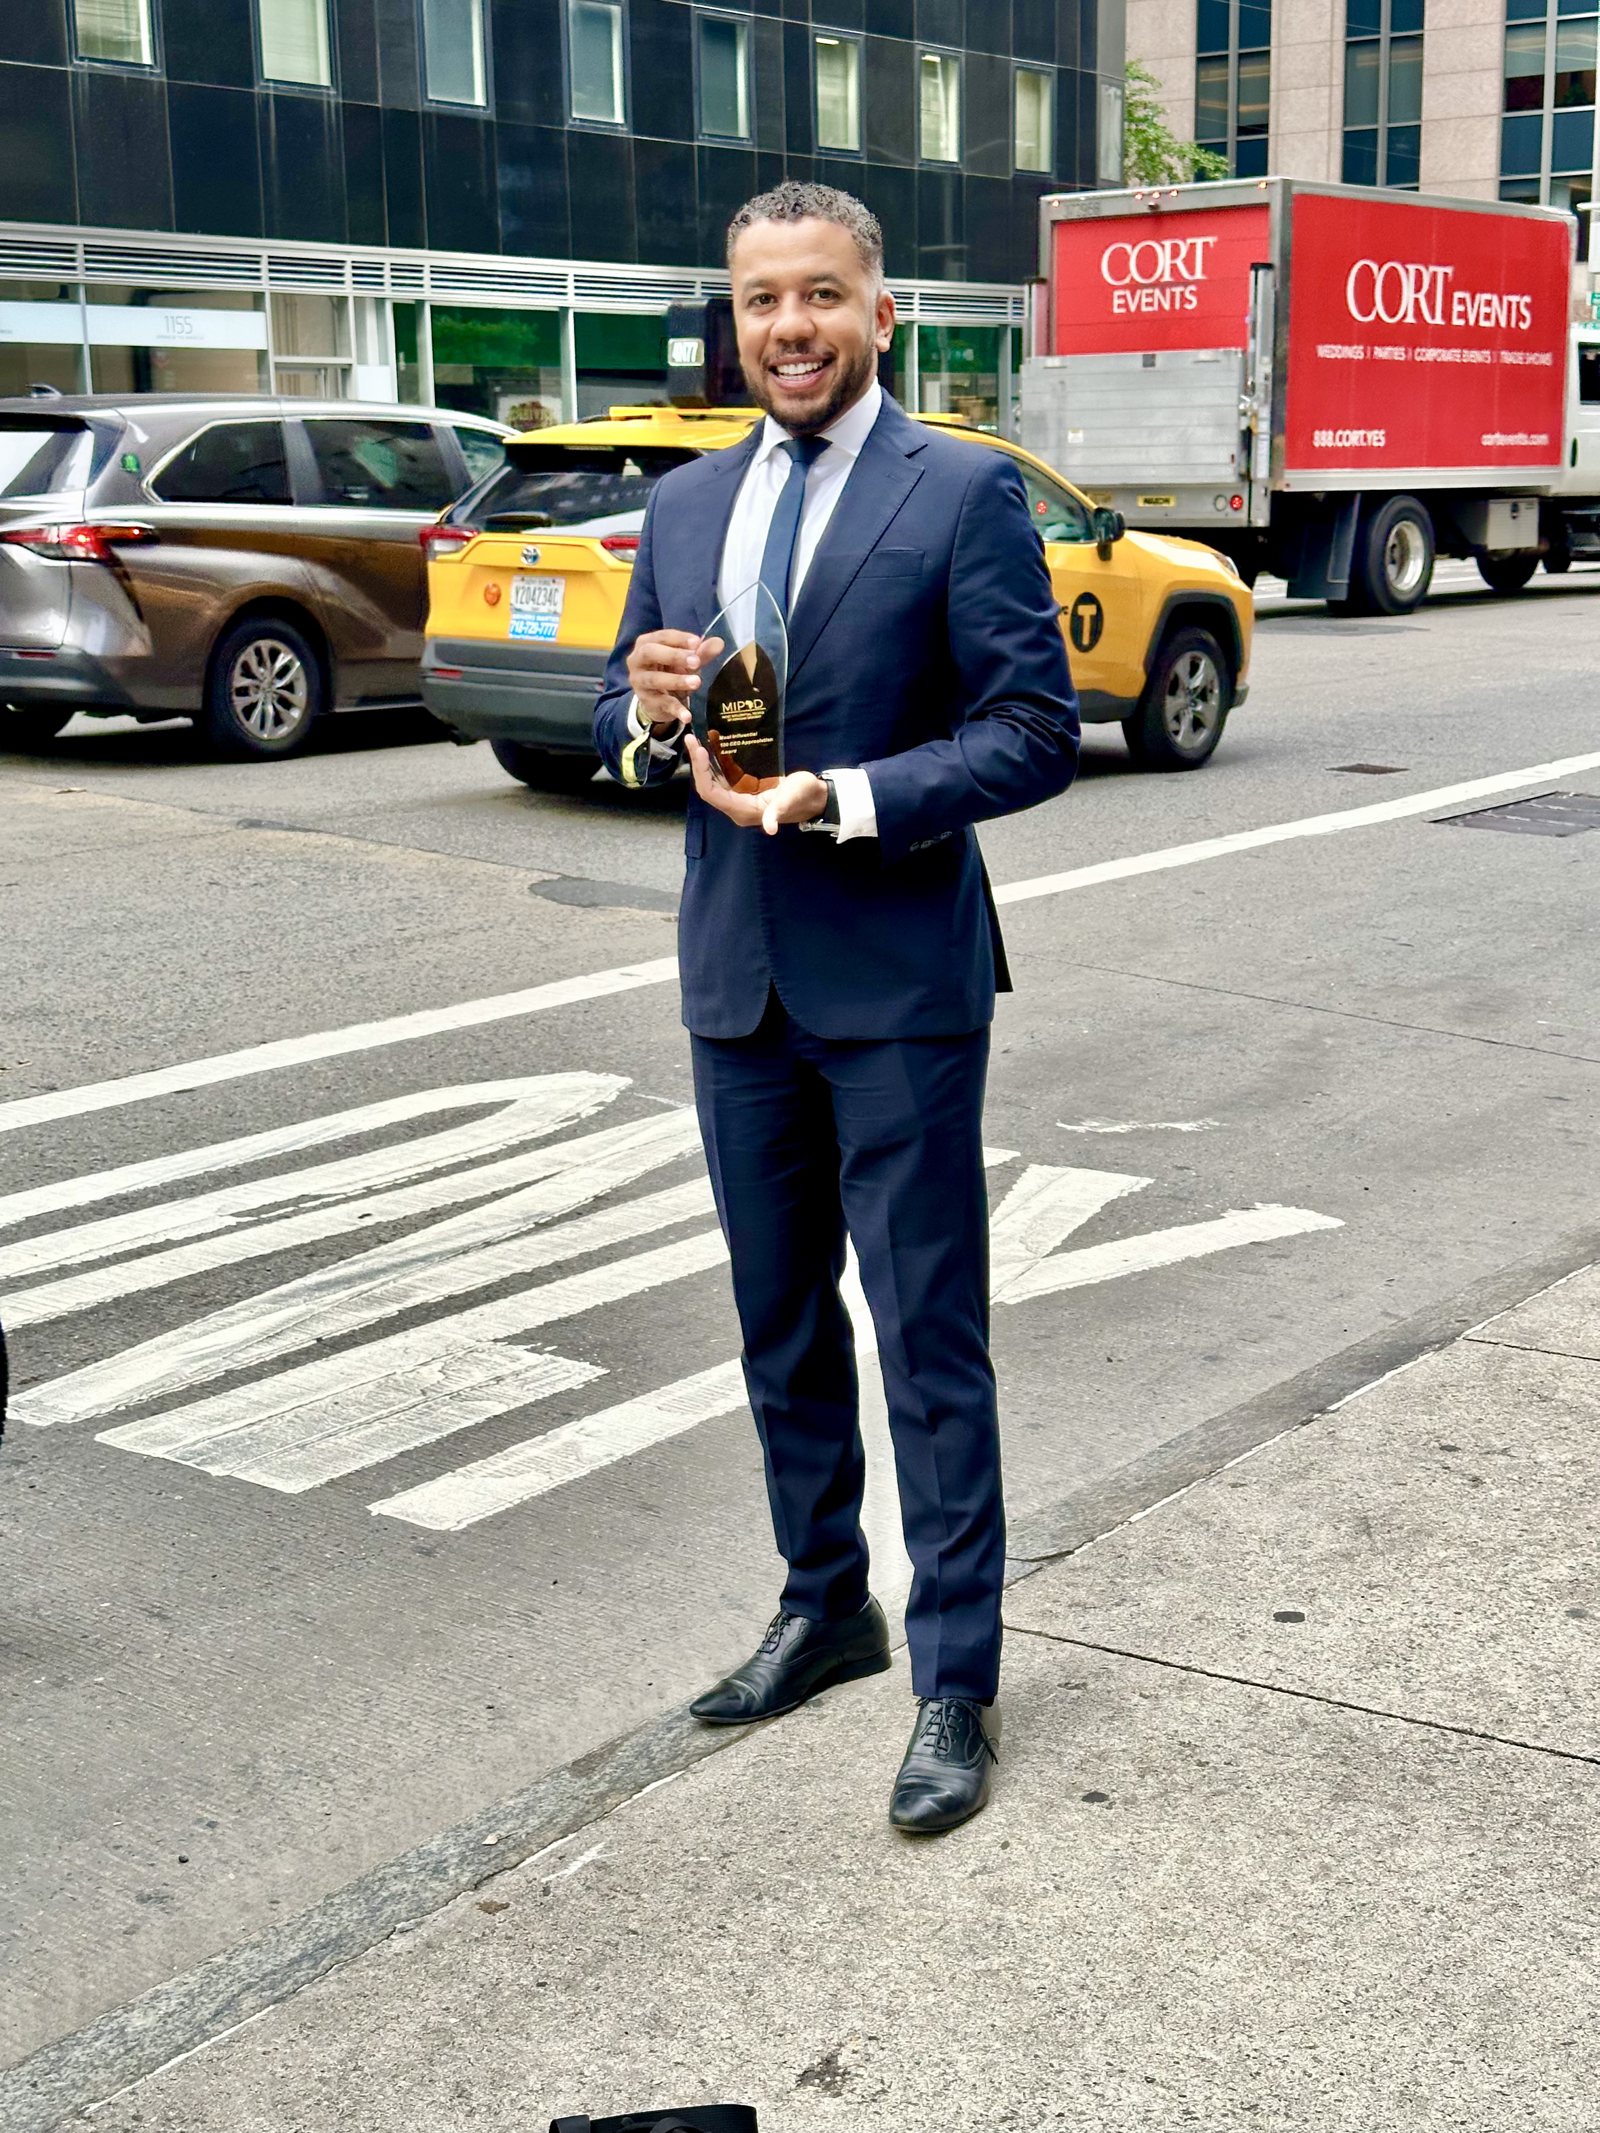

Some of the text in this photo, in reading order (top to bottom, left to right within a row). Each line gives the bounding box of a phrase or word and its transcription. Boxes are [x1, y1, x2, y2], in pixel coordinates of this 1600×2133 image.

[1101, 236, 1216, 286] CORT
[1113, 286, 1197, 314] EVENTS
[1346, 259, 1532, 330] CORT EVENTS
[164, 315, 192, 334] 1155
[1316, 344, 1364, 359] WEDDINGS
[1373, 346, 1406, 361] PARTIES
[1414, 347, 1461, 363] CORPORATE
[1462, 349, 1491, 364] EVENTS
[1077, 604, 1097, 645] T
